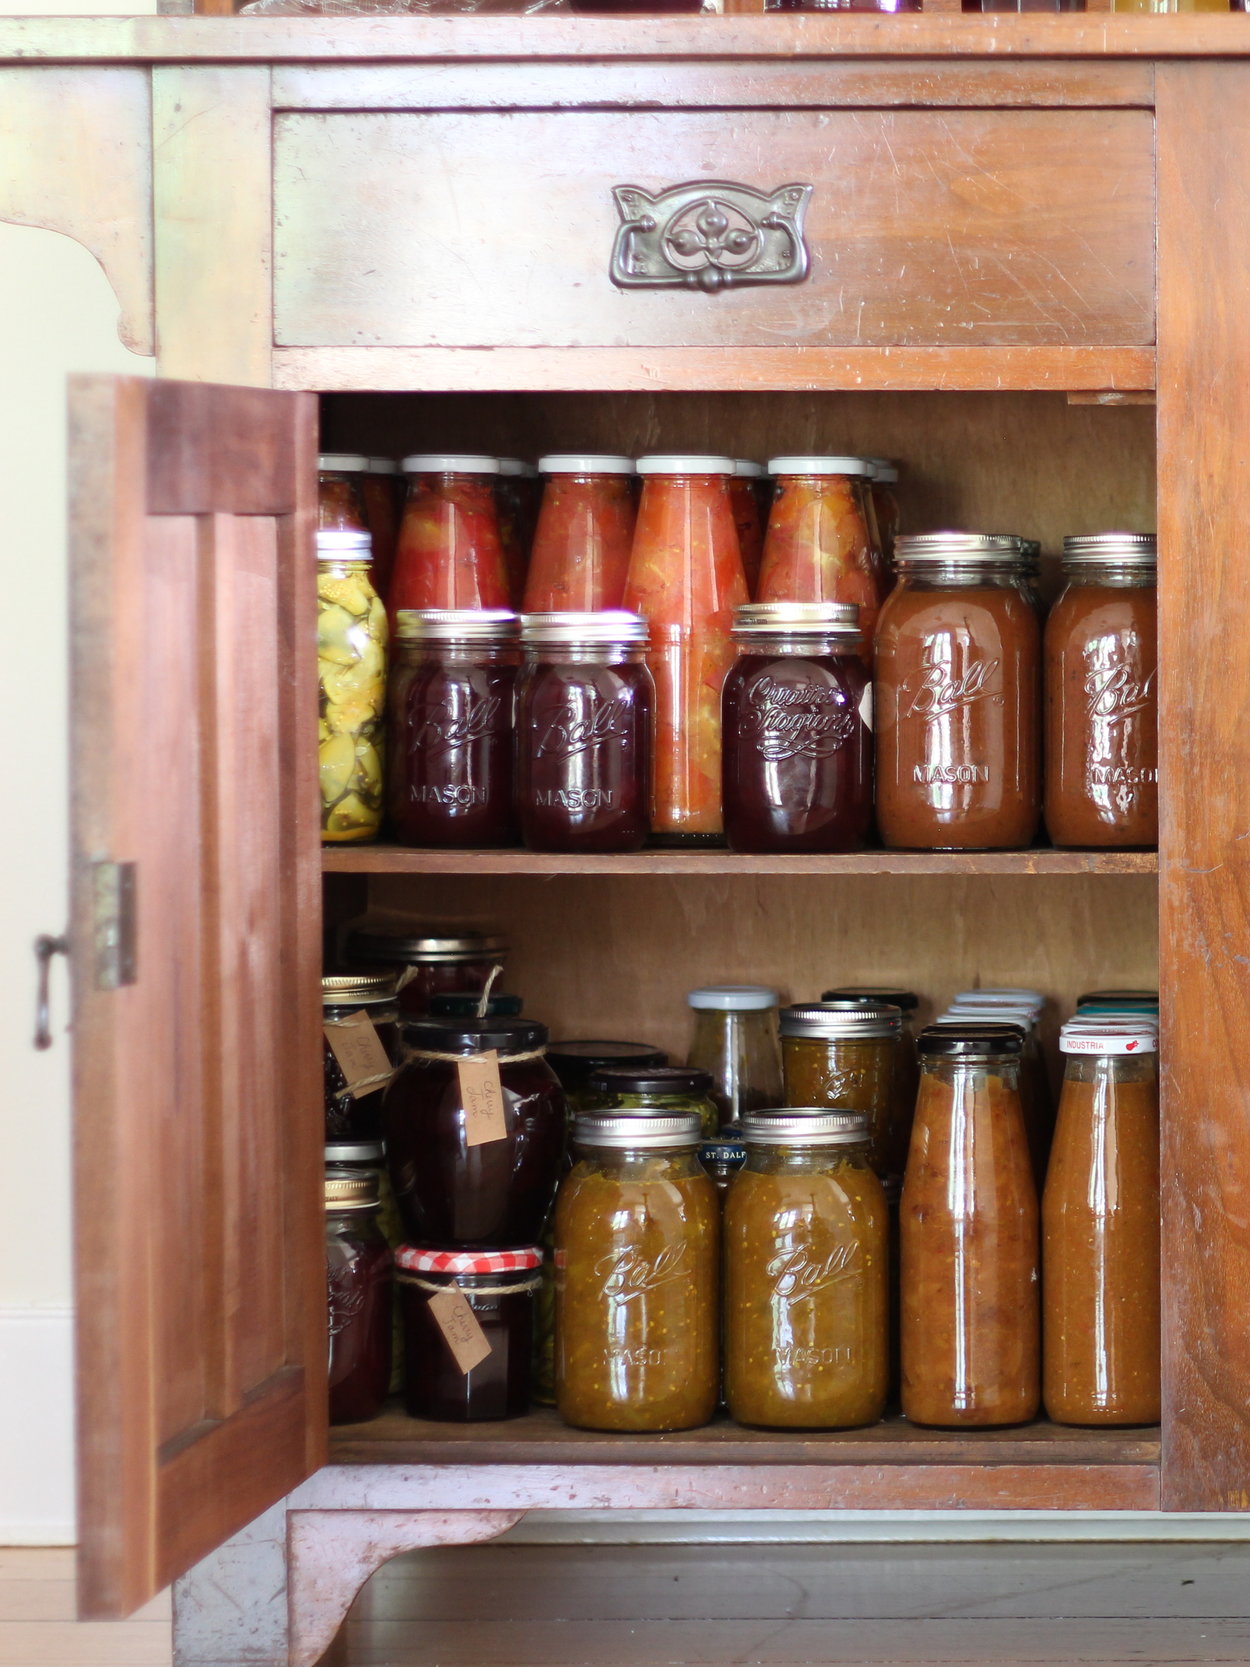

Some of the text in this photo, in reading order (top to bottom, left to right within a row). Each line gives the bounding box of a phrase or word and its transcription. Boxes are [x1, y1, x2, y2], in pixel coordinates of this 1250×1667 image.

[902, 659, 1001, 721] Ball
[1084, 660, 1158, 725] Bal
[913, 763, 990, 783] MASON
[1092, 766, 1158, 783] MASO
[410, 784, 487, 804] MASON
[536, 789, 613, 809] MASON
[1066, 1040, 1104, 1050] INDUSTRIA
[466, 1086, 482, 1119] Jam
[480, 1080, 497, 1119] Cherry
[705, 1151, 747, 1159] ST. DALF
[594, 1239, 691, 1306] Ball
[766, 1239, 863, 1306] Ball
